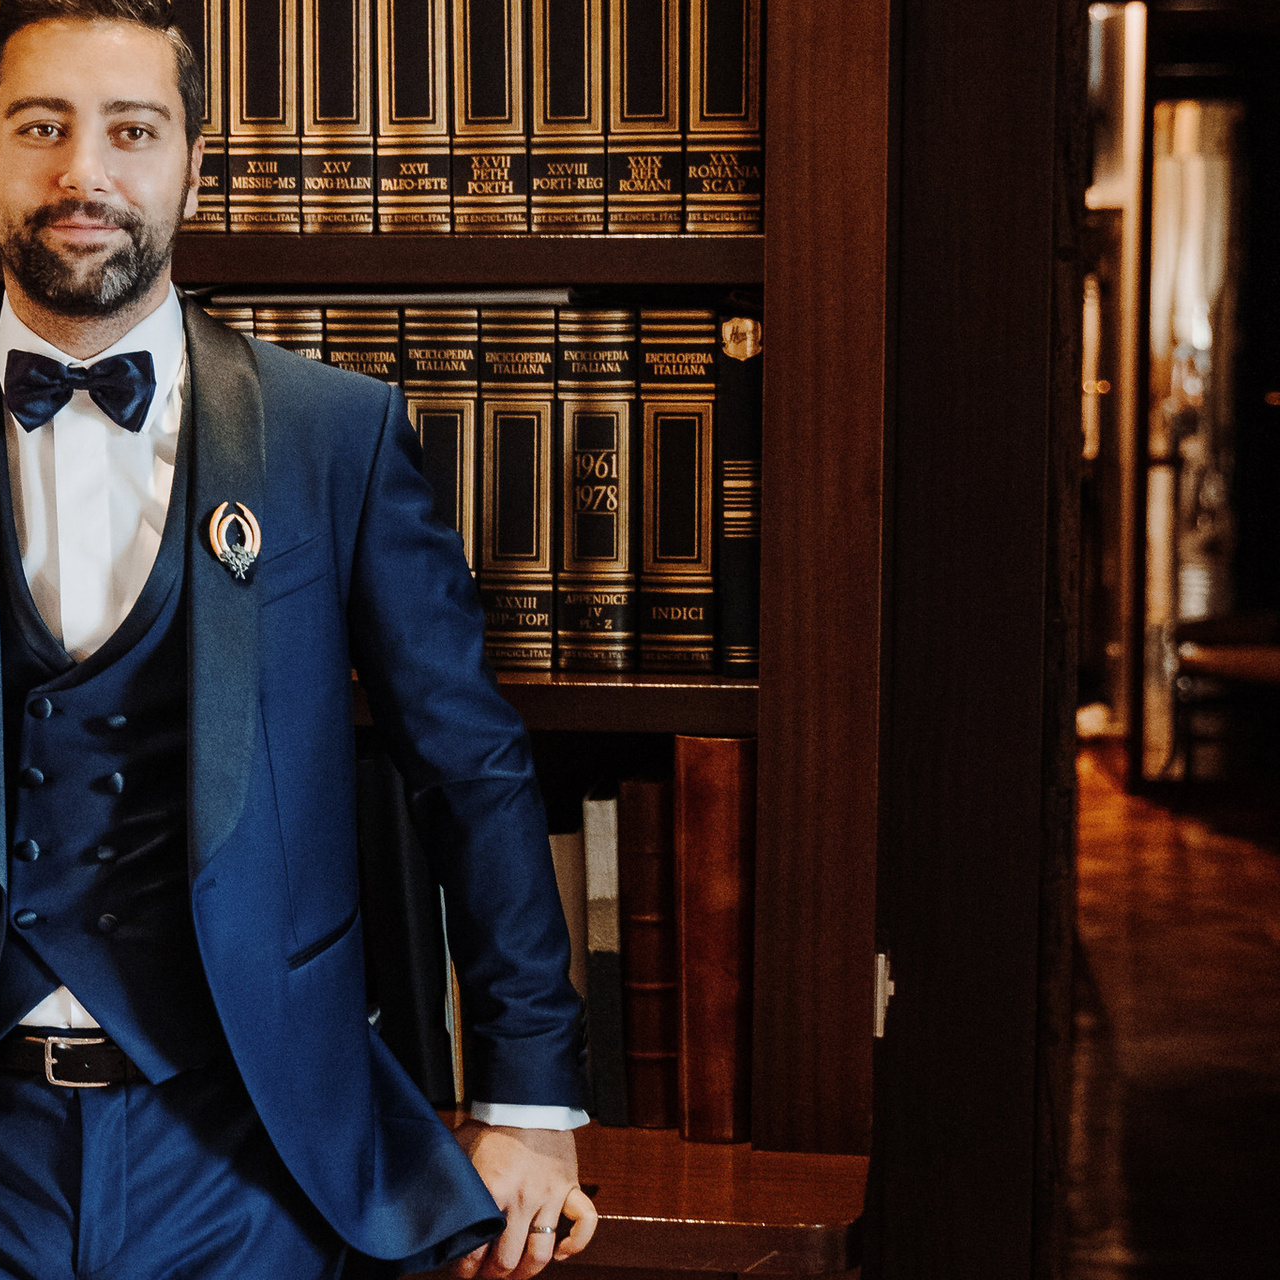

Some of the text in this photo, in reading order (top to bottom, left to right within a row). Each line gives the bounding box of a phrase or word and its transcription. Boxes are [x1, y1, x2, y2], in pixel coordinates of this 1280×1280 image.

[471, 156, 511, 168] XXVII
[627, 156, 662, 168] XXIX
[709, 154, 738, 166] XXX
[247, 161, 278, 173] XXIII
[323, 161, 351, 173] XXV
[399, 163, 429, 175] XXVI
[547, 163, 588, 175] XXVIII
[688, 165, 760, 178] ROMANIA
[473, 169, 508, 180] PETH
[381, 178, 447, 191] PALEO-PETE
[467, 181, 513, 194] PORTH
[533, 177, 603, 190] PORTI-REG
[619, 179, 671, 192] ROMANI
[702, 180, 746, 192] SCAP
[409, 349, 474, 360] ENCICLOPEDIA
[564, 350, 629, 361] ENCICLOPEDIA
[645, 352, 713, 364] ENCICLOPEDIA
[416, 360, 467, 371] ITALIANA
[572, 362, 621, 373] ITALIANA
[654, 364, 705, 375] ITALIANA
[575, 453, 618, 478] 1961
[575, 486, 618, 511] 1978
[495, 597, 537, 609] XXXIII
[565, 594, 628, 605] APPENDICE
[588, 608, 602, 618] IV
[652, 607, 704, 620] INDICI
